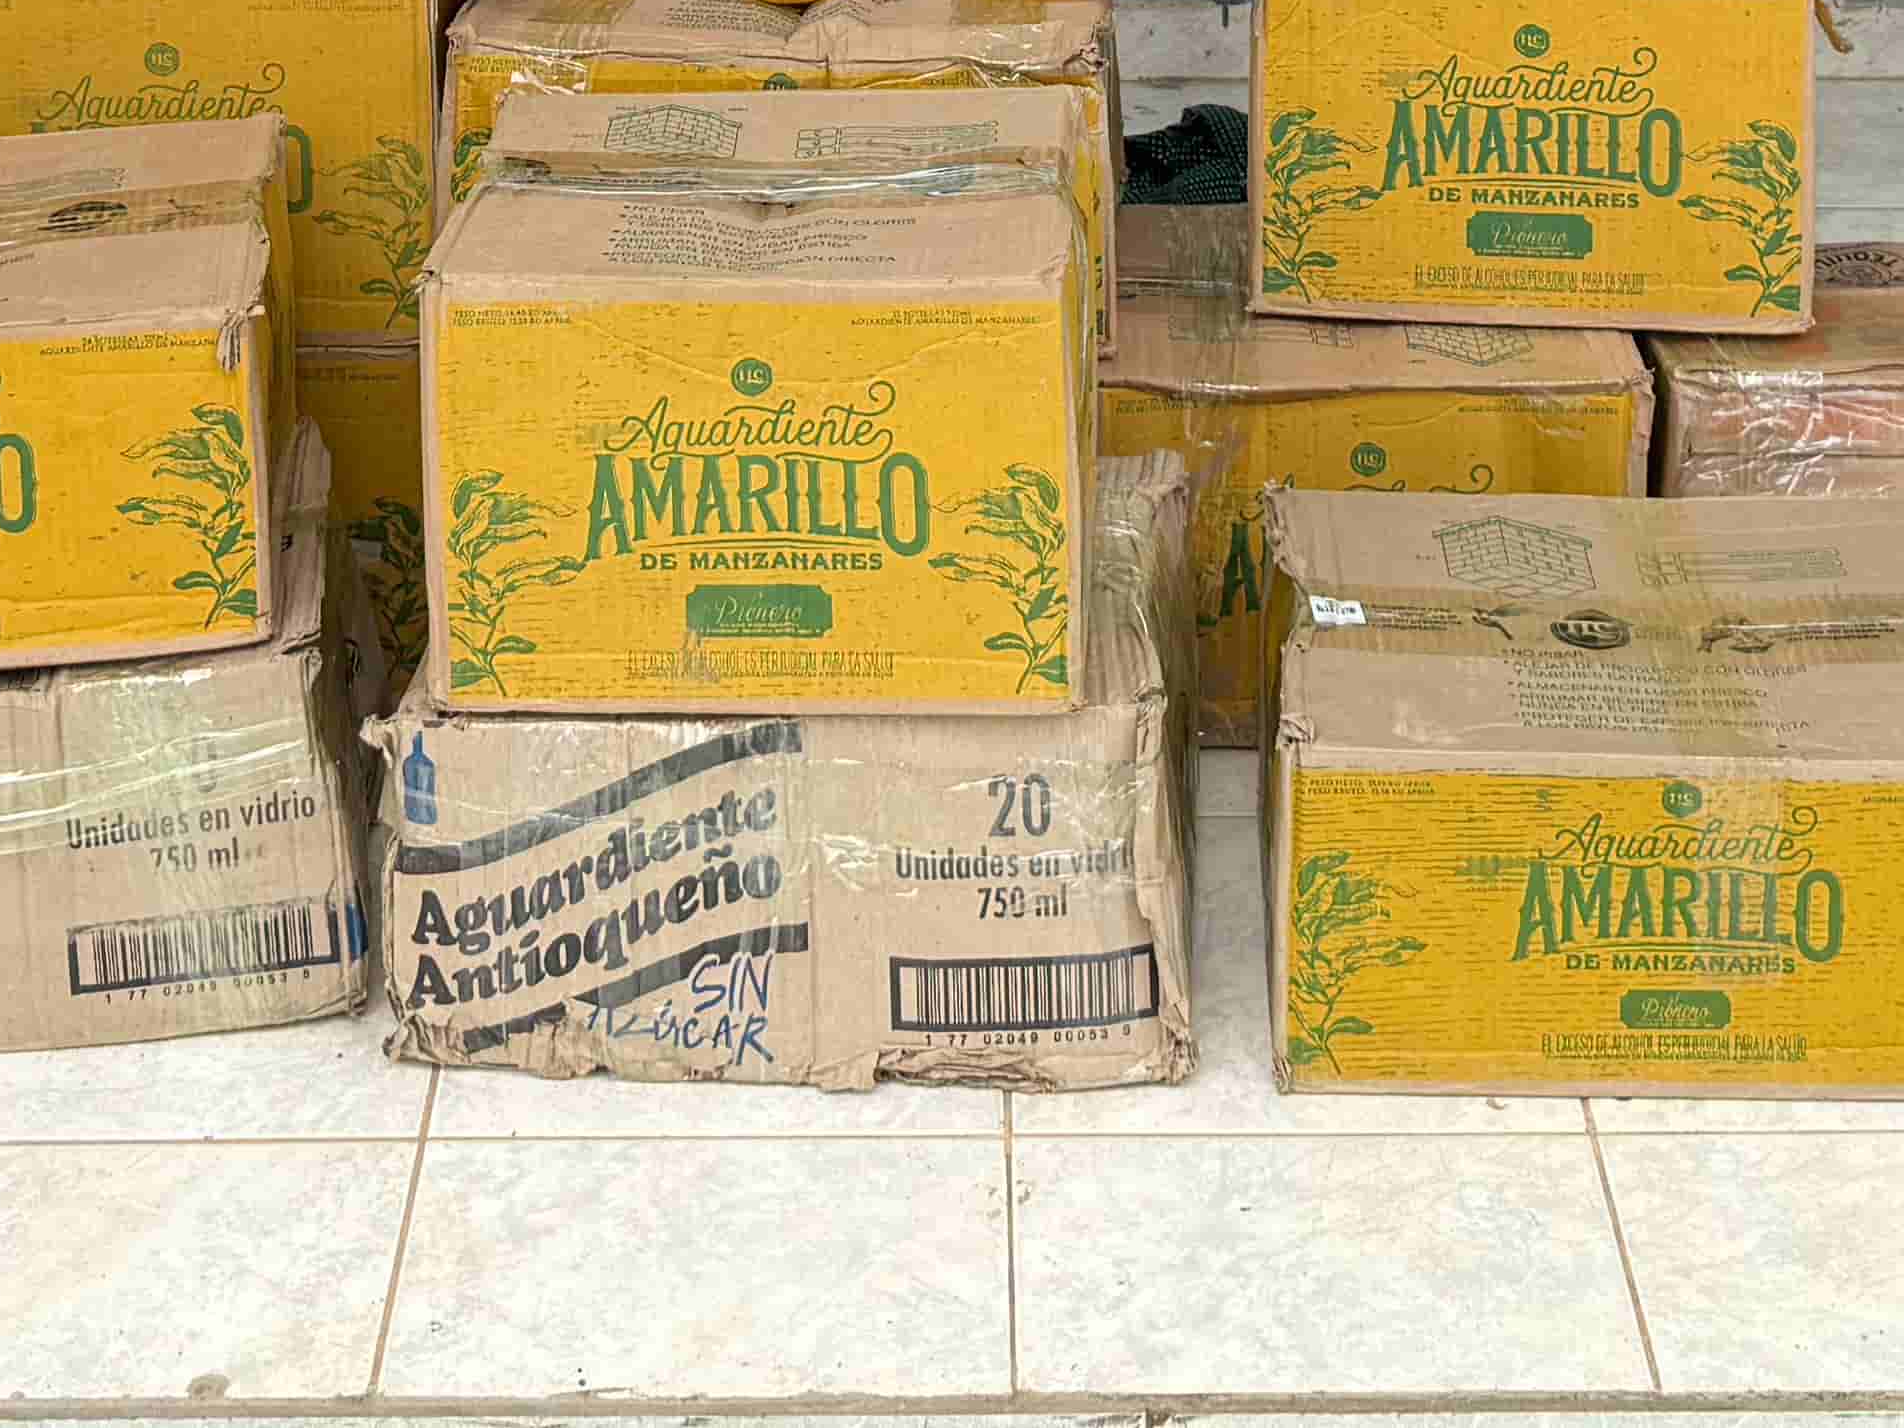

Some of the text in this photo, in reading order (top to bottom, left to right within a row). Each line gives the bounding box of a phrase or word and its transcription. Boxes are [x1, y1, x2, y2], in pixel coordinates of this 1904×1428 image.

[37, 63, 286, 124] Aguardiente
[1402, 47, 1657, 117] Aguardiente
[1382, 99, 1683, 196] AMARILLO
[1428, 187, 1640, 209] DE MANZANARES
[604, 379, 897, 465] Aguardiente
[585, 450, 929, 563] AMARILLO
[639, 550, 884, 572] DE MANZANARES
[65, 791, 316, 850] Unidades en vidrio
[988, 772, 1052, 838] 20
[207, 836, 239, 869] ml
[410, 783, 778, 953] Aguardiente
[895, 839, 1134, 881] Unidades en vidri
[1539, 805, 1818, 877] Aguardiente
[405, 843, 784, 1013] Antioqueño
[977, 883, 1069, 920] 750 ml
[1511, 859, 1843, 963] AMARILLO
[689, 952, 775, 1013] SIN
[1565, 953, 1600, 972] DE
[586, 999, 775, 1066] AZÚCAR
[948, 1032, 969, 1047] 77
[982, 1030, 1040, 1046] 02049
